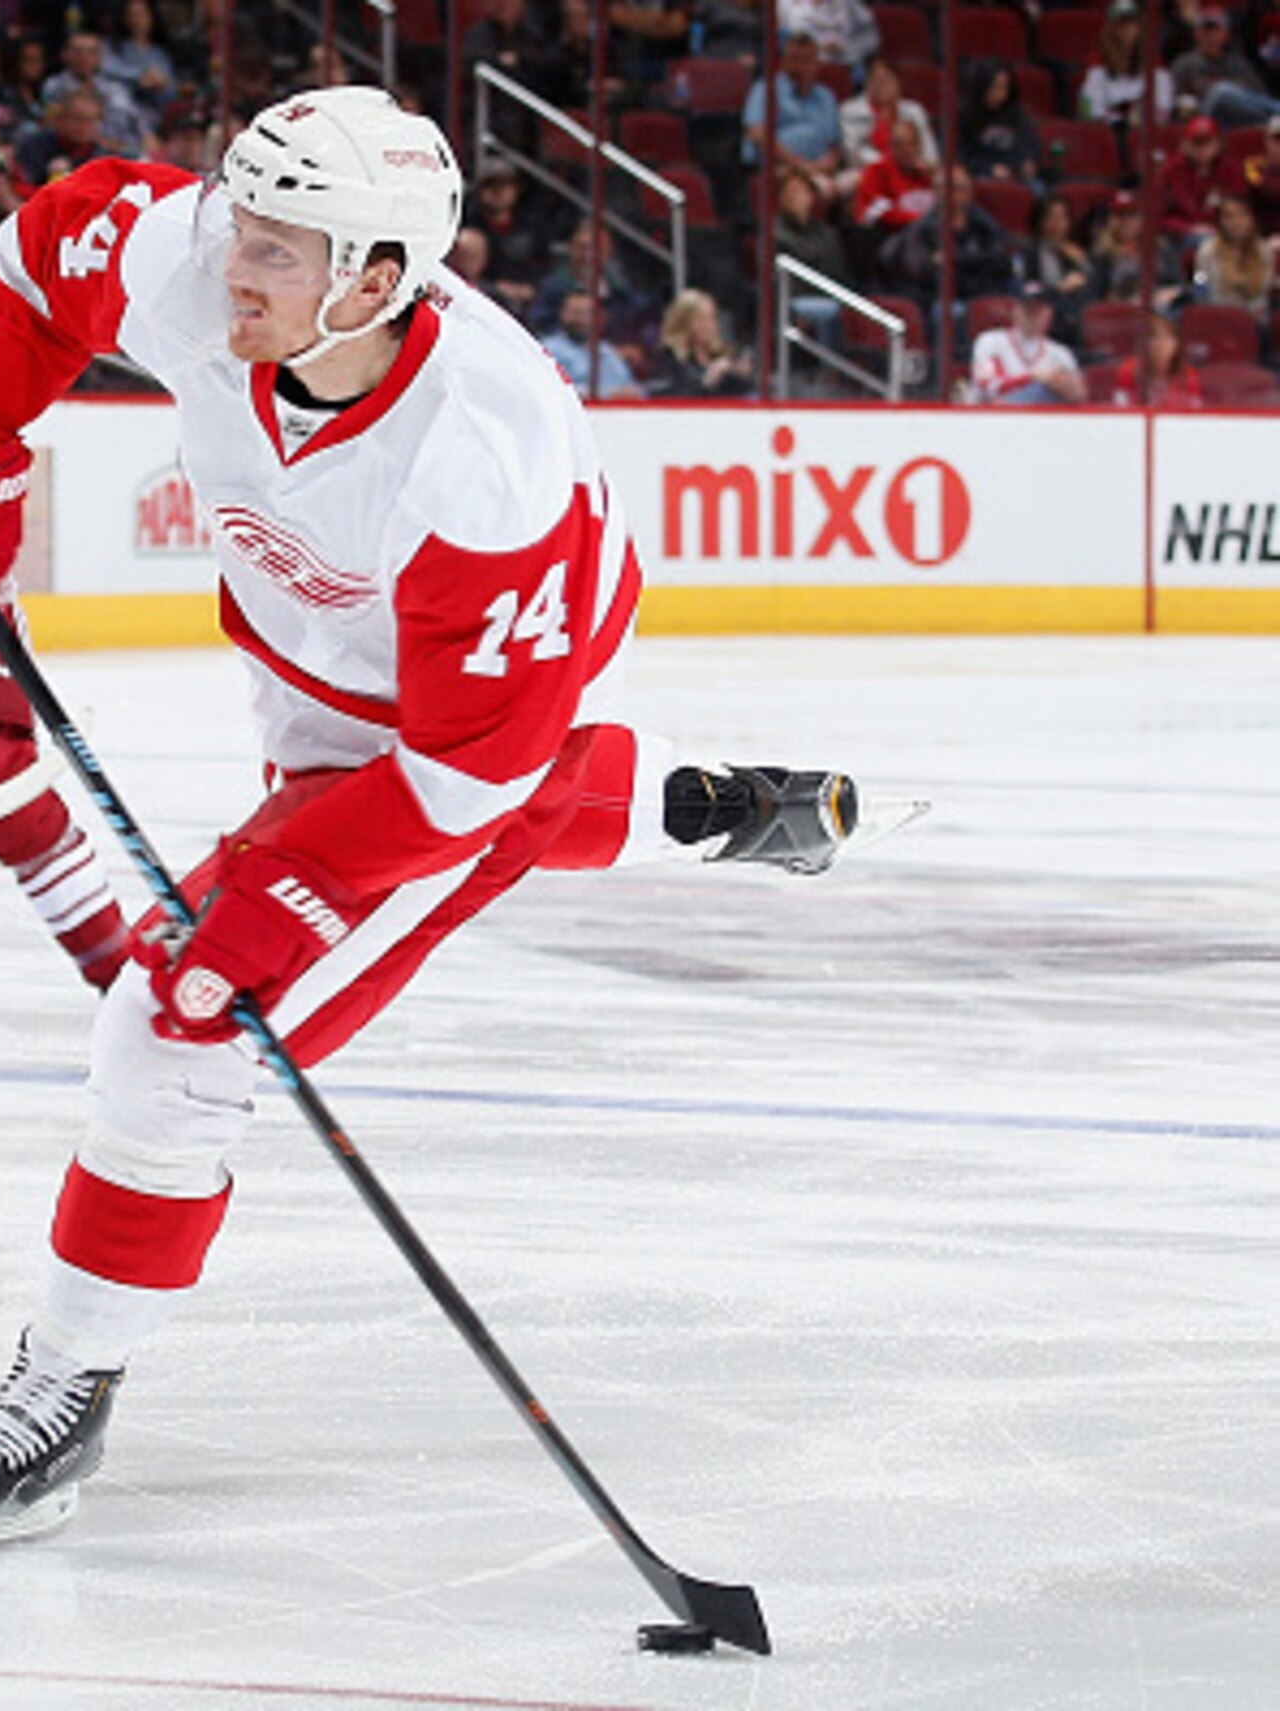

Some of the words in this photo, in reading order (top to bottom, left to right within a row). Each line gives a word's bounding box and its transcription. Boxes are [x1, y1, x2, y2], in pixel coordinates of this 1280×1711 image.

[661, 425, 972, 568] mix1
[1163, 502, 1280, 563] NHL
[461, 560, 573, 678] 14
